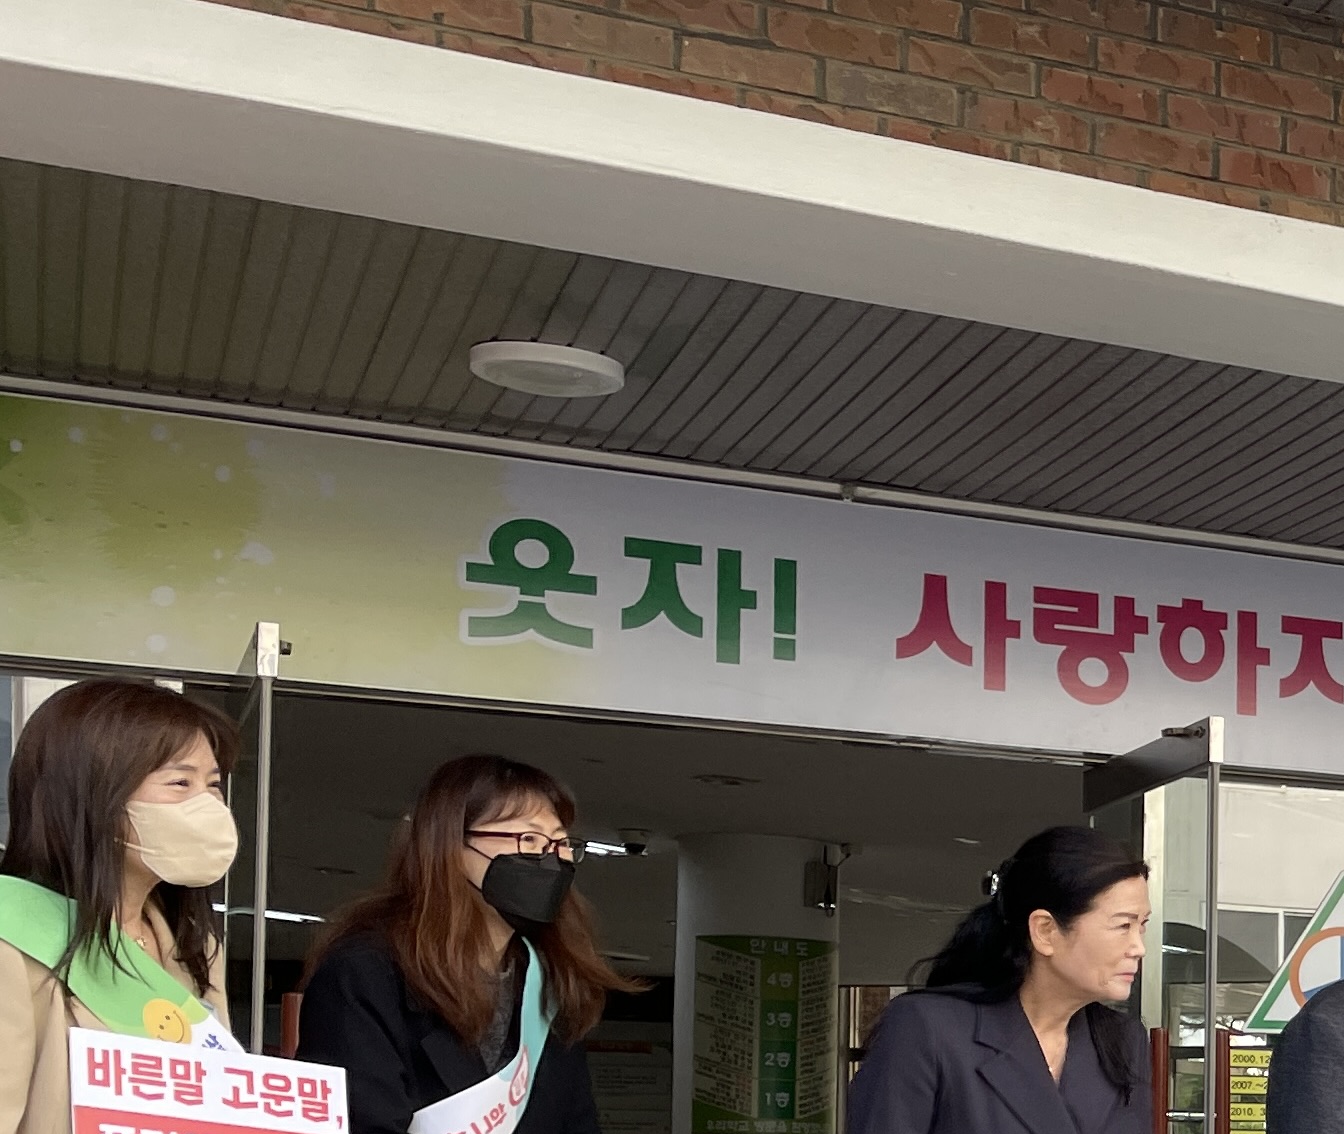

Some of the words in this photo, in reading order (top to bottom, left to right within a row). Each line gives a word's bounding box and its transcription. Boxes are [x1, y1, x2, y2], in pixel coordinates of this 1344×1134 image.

[465, 518, 798, 664] 웃자!
[765, 972, 793, 988] 4층
[765, 1012, 792, 1028] 3층
[764, 1052, 791, 1068] 2층
[87, 1048, 206, 1107] 바른말
[223, 1065, 344, 1130] 고운말,
[765, 1092, 790, 1108] 1층
